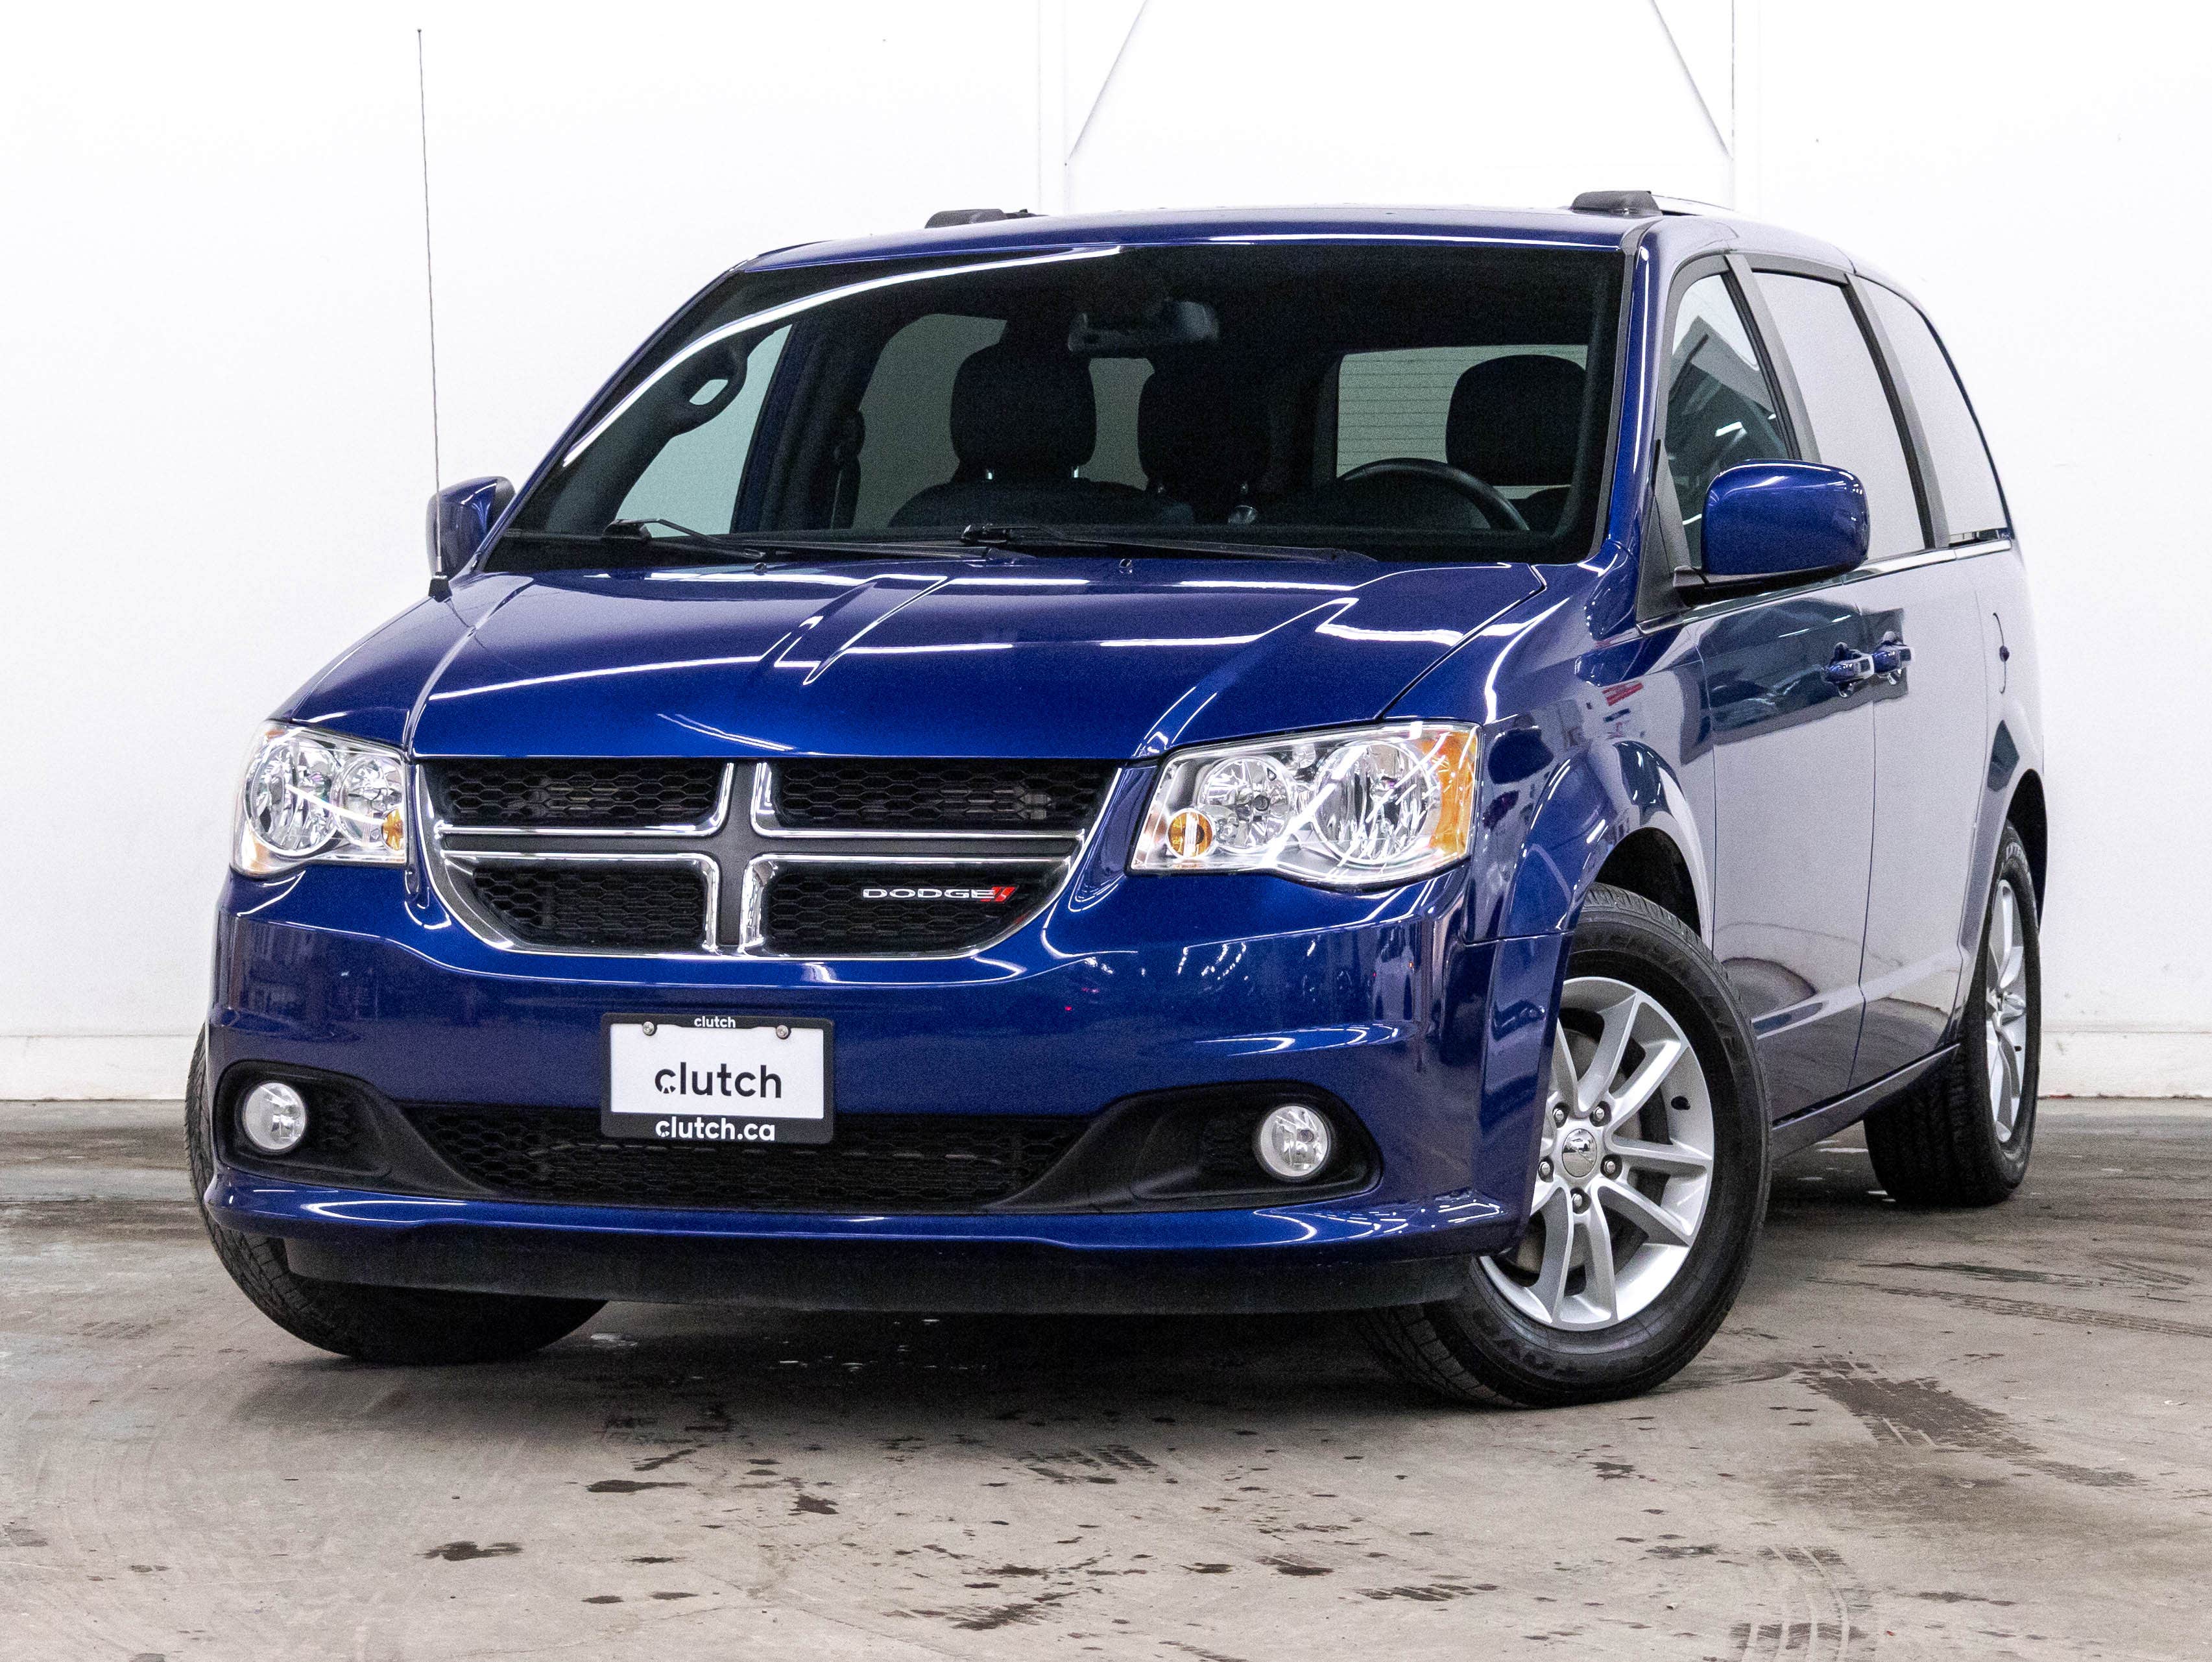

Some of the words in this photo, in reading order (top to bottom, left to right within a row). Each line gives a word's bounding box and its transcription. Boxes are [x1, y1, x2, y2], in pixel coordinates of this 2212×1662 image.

[863, 888, 996, 898] DODGE
[693, 1015, 736, 1028] clutch
[655, 1061, 782, 1098] clutch
[655, 1116, 776, 1141] clutch.ca
